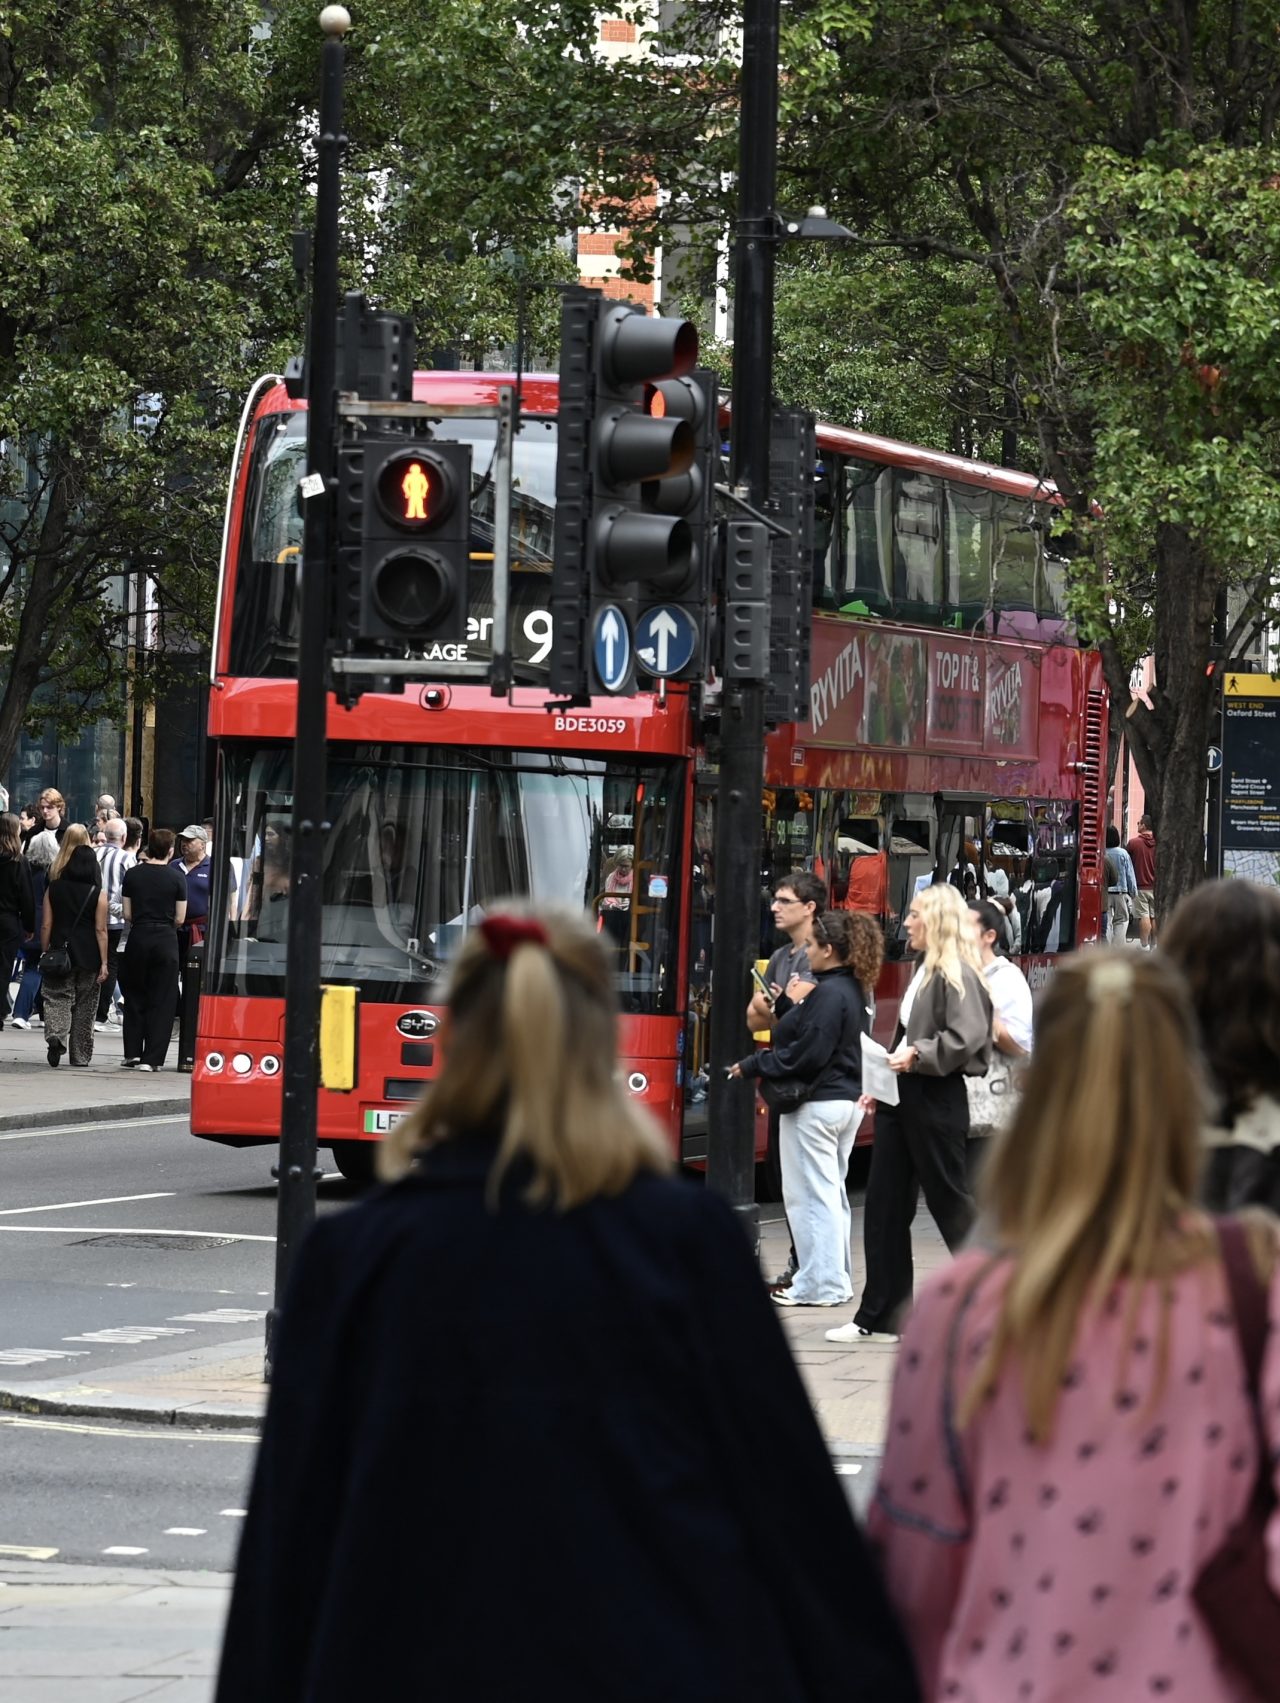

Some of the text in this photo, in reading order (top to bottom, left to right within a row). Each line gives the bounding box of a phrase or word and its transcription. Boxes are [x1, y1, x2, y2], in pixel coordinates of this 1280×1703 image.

[935, 651, 960, 689] TOP
[960, 654, 972, 691] IT
[810, 635, 863, 735] RYVITA
[991, 661, 1022, 724] RYVITA
[1226, 709, 1277, 718] Oxford Street
[554, 716, 626, 733] BDE3059
[400, 1018, 436, 1031] BYD
[376, 1112, 409, 1130] LF
